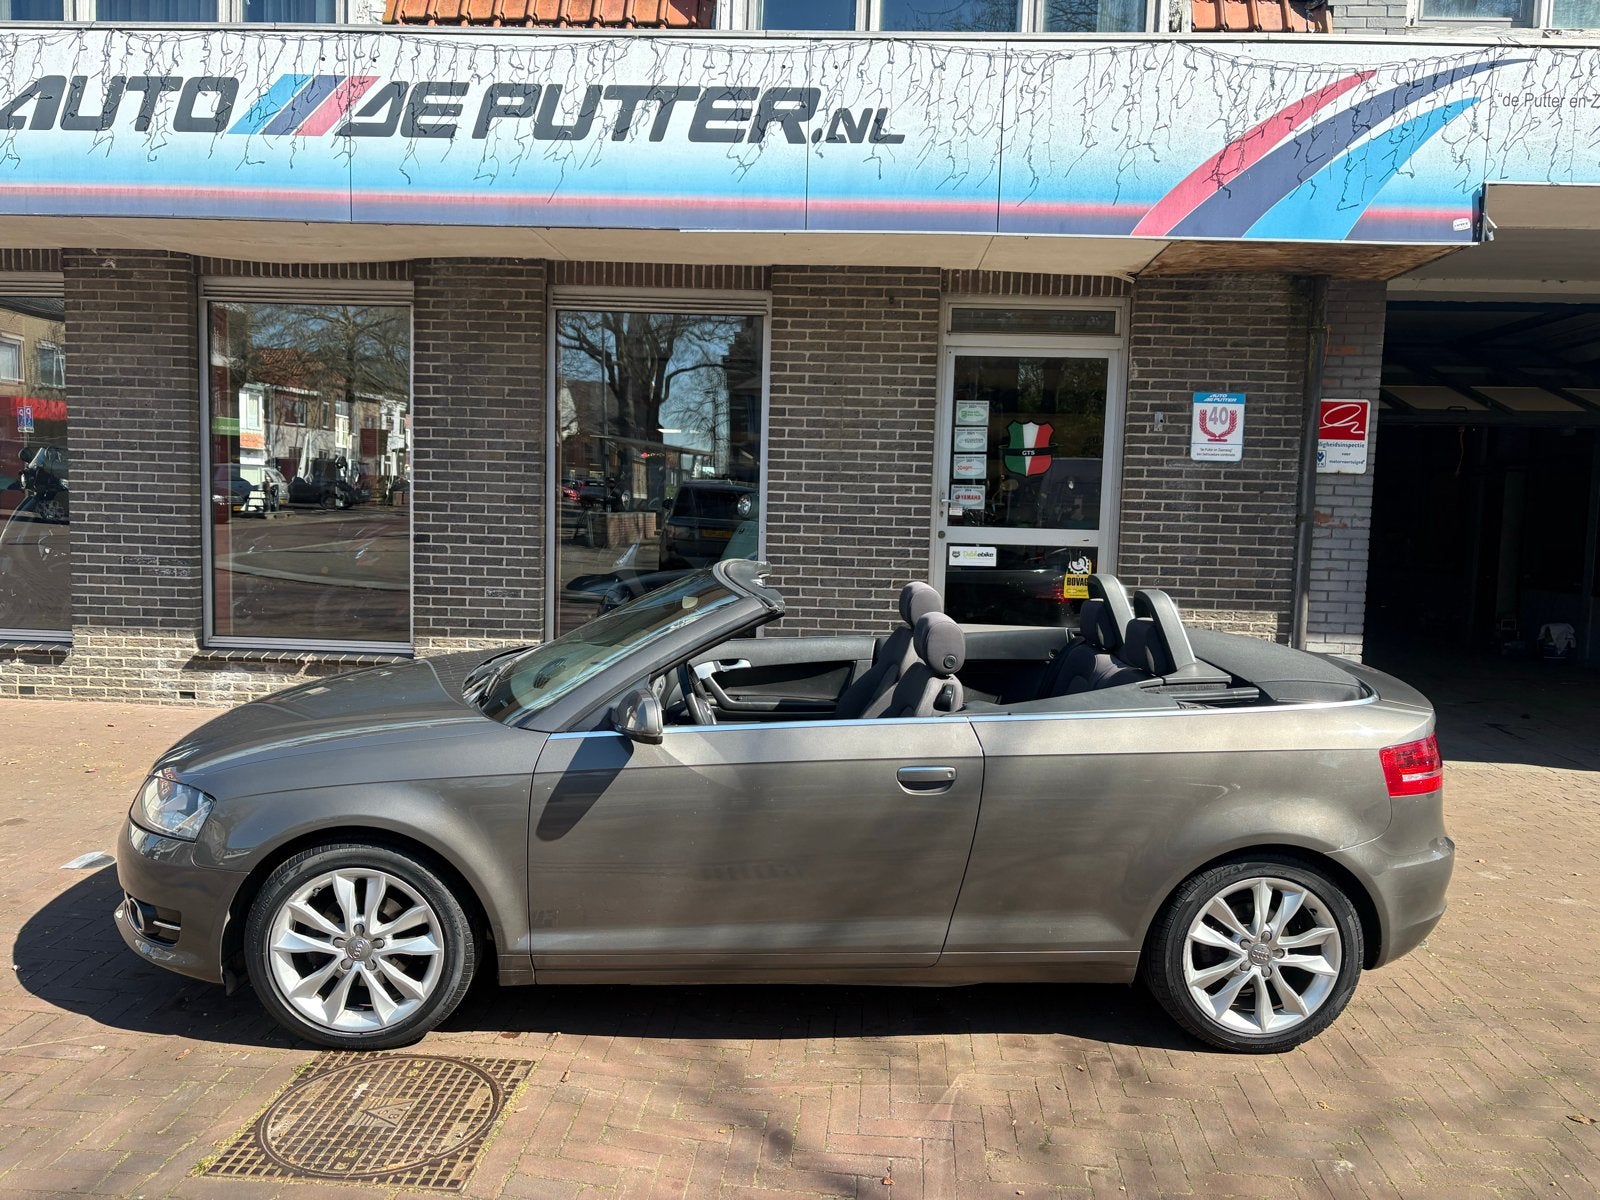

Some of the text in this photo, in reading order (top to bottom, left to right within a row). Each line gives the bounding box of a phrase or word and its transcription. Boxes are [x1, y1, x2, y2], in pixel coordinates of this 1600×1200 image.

[0, 75, 240, 132] AUTO
[1524, 93, 1565, 108] Putter
[1569, 96, 1586, 108] en
[1208, 406, 1229, 425] 40
